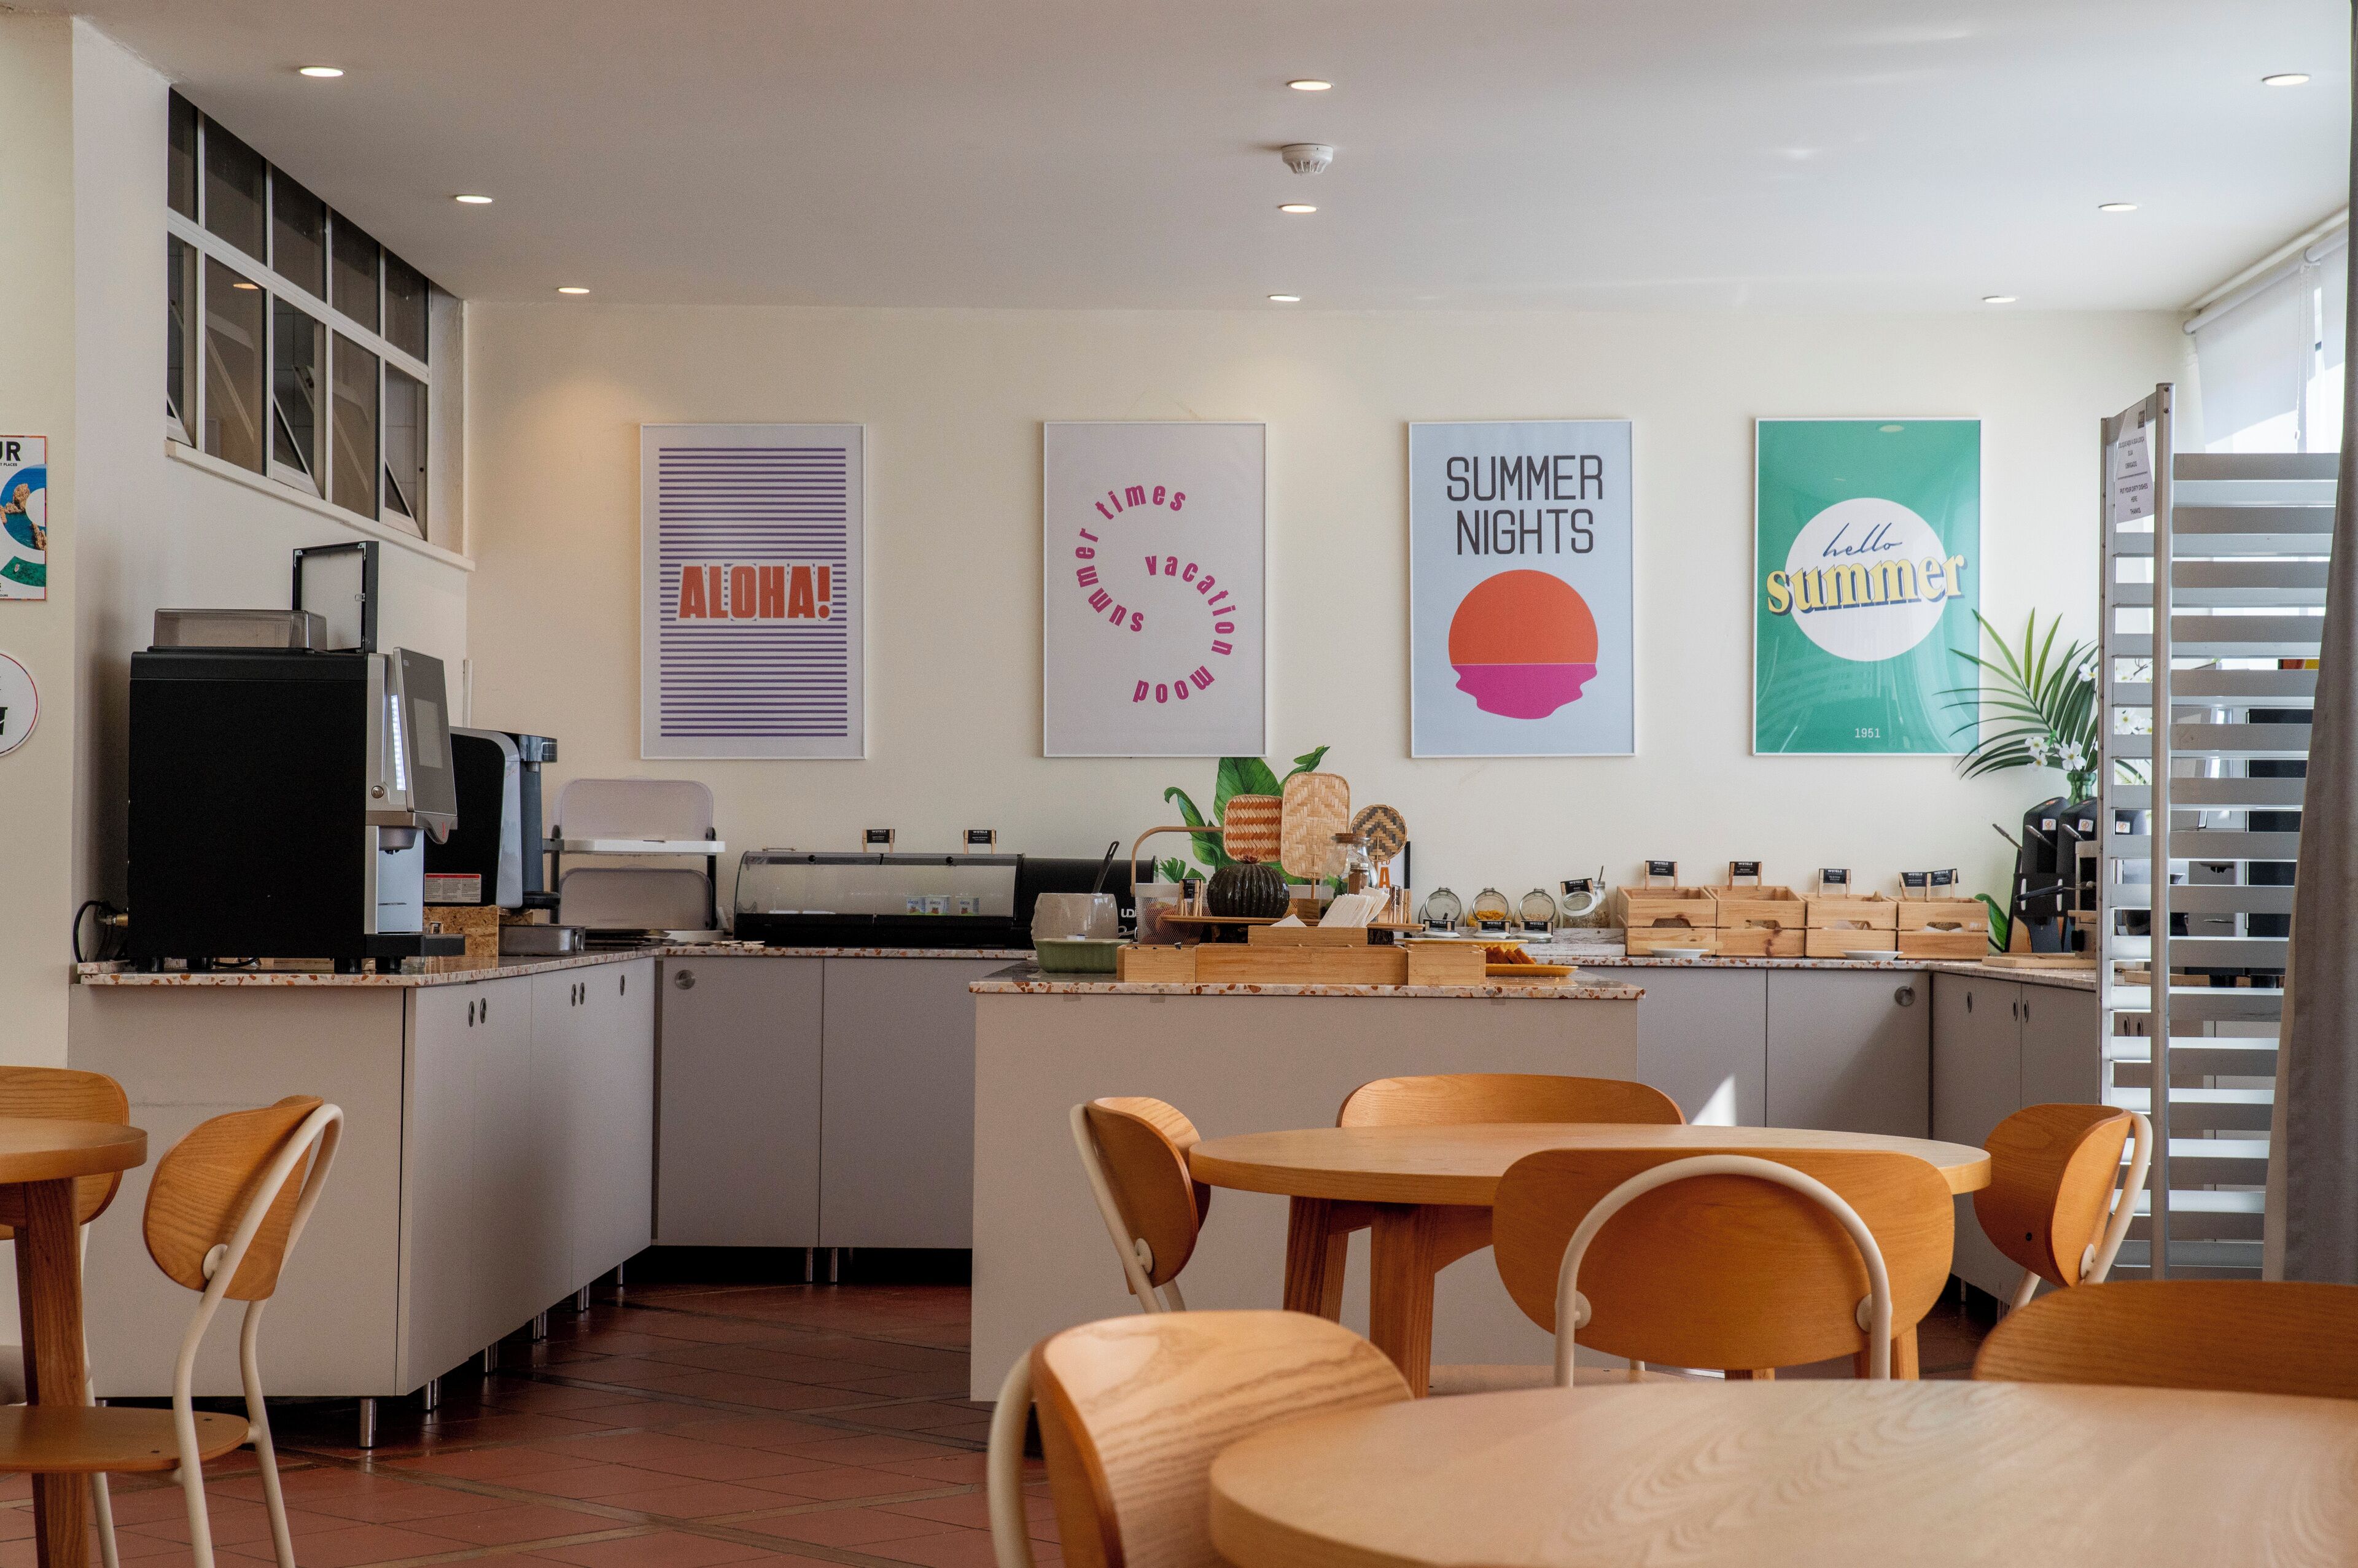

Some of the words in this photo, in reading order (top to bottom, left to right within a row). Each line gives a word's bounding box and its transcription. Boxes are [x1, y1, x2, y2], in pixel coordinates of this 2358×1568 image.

[1447, 455, 1603, 501] SUMMER
[1095, 485, 1186, 520] times
[1457, 509, 1593, 555] NIGHTS
[1823, 522, 1903, 557] hello
[679, 566, 830, 618] ALOHA!
[1075, 528, 1143, 632] summer
[1767, 553, 1968, 616] summer
[1145, 556, 1236, 656] vacation
[1132, 666, 1215, 704] mood
[1854, 728, 1880, 738] 1951
